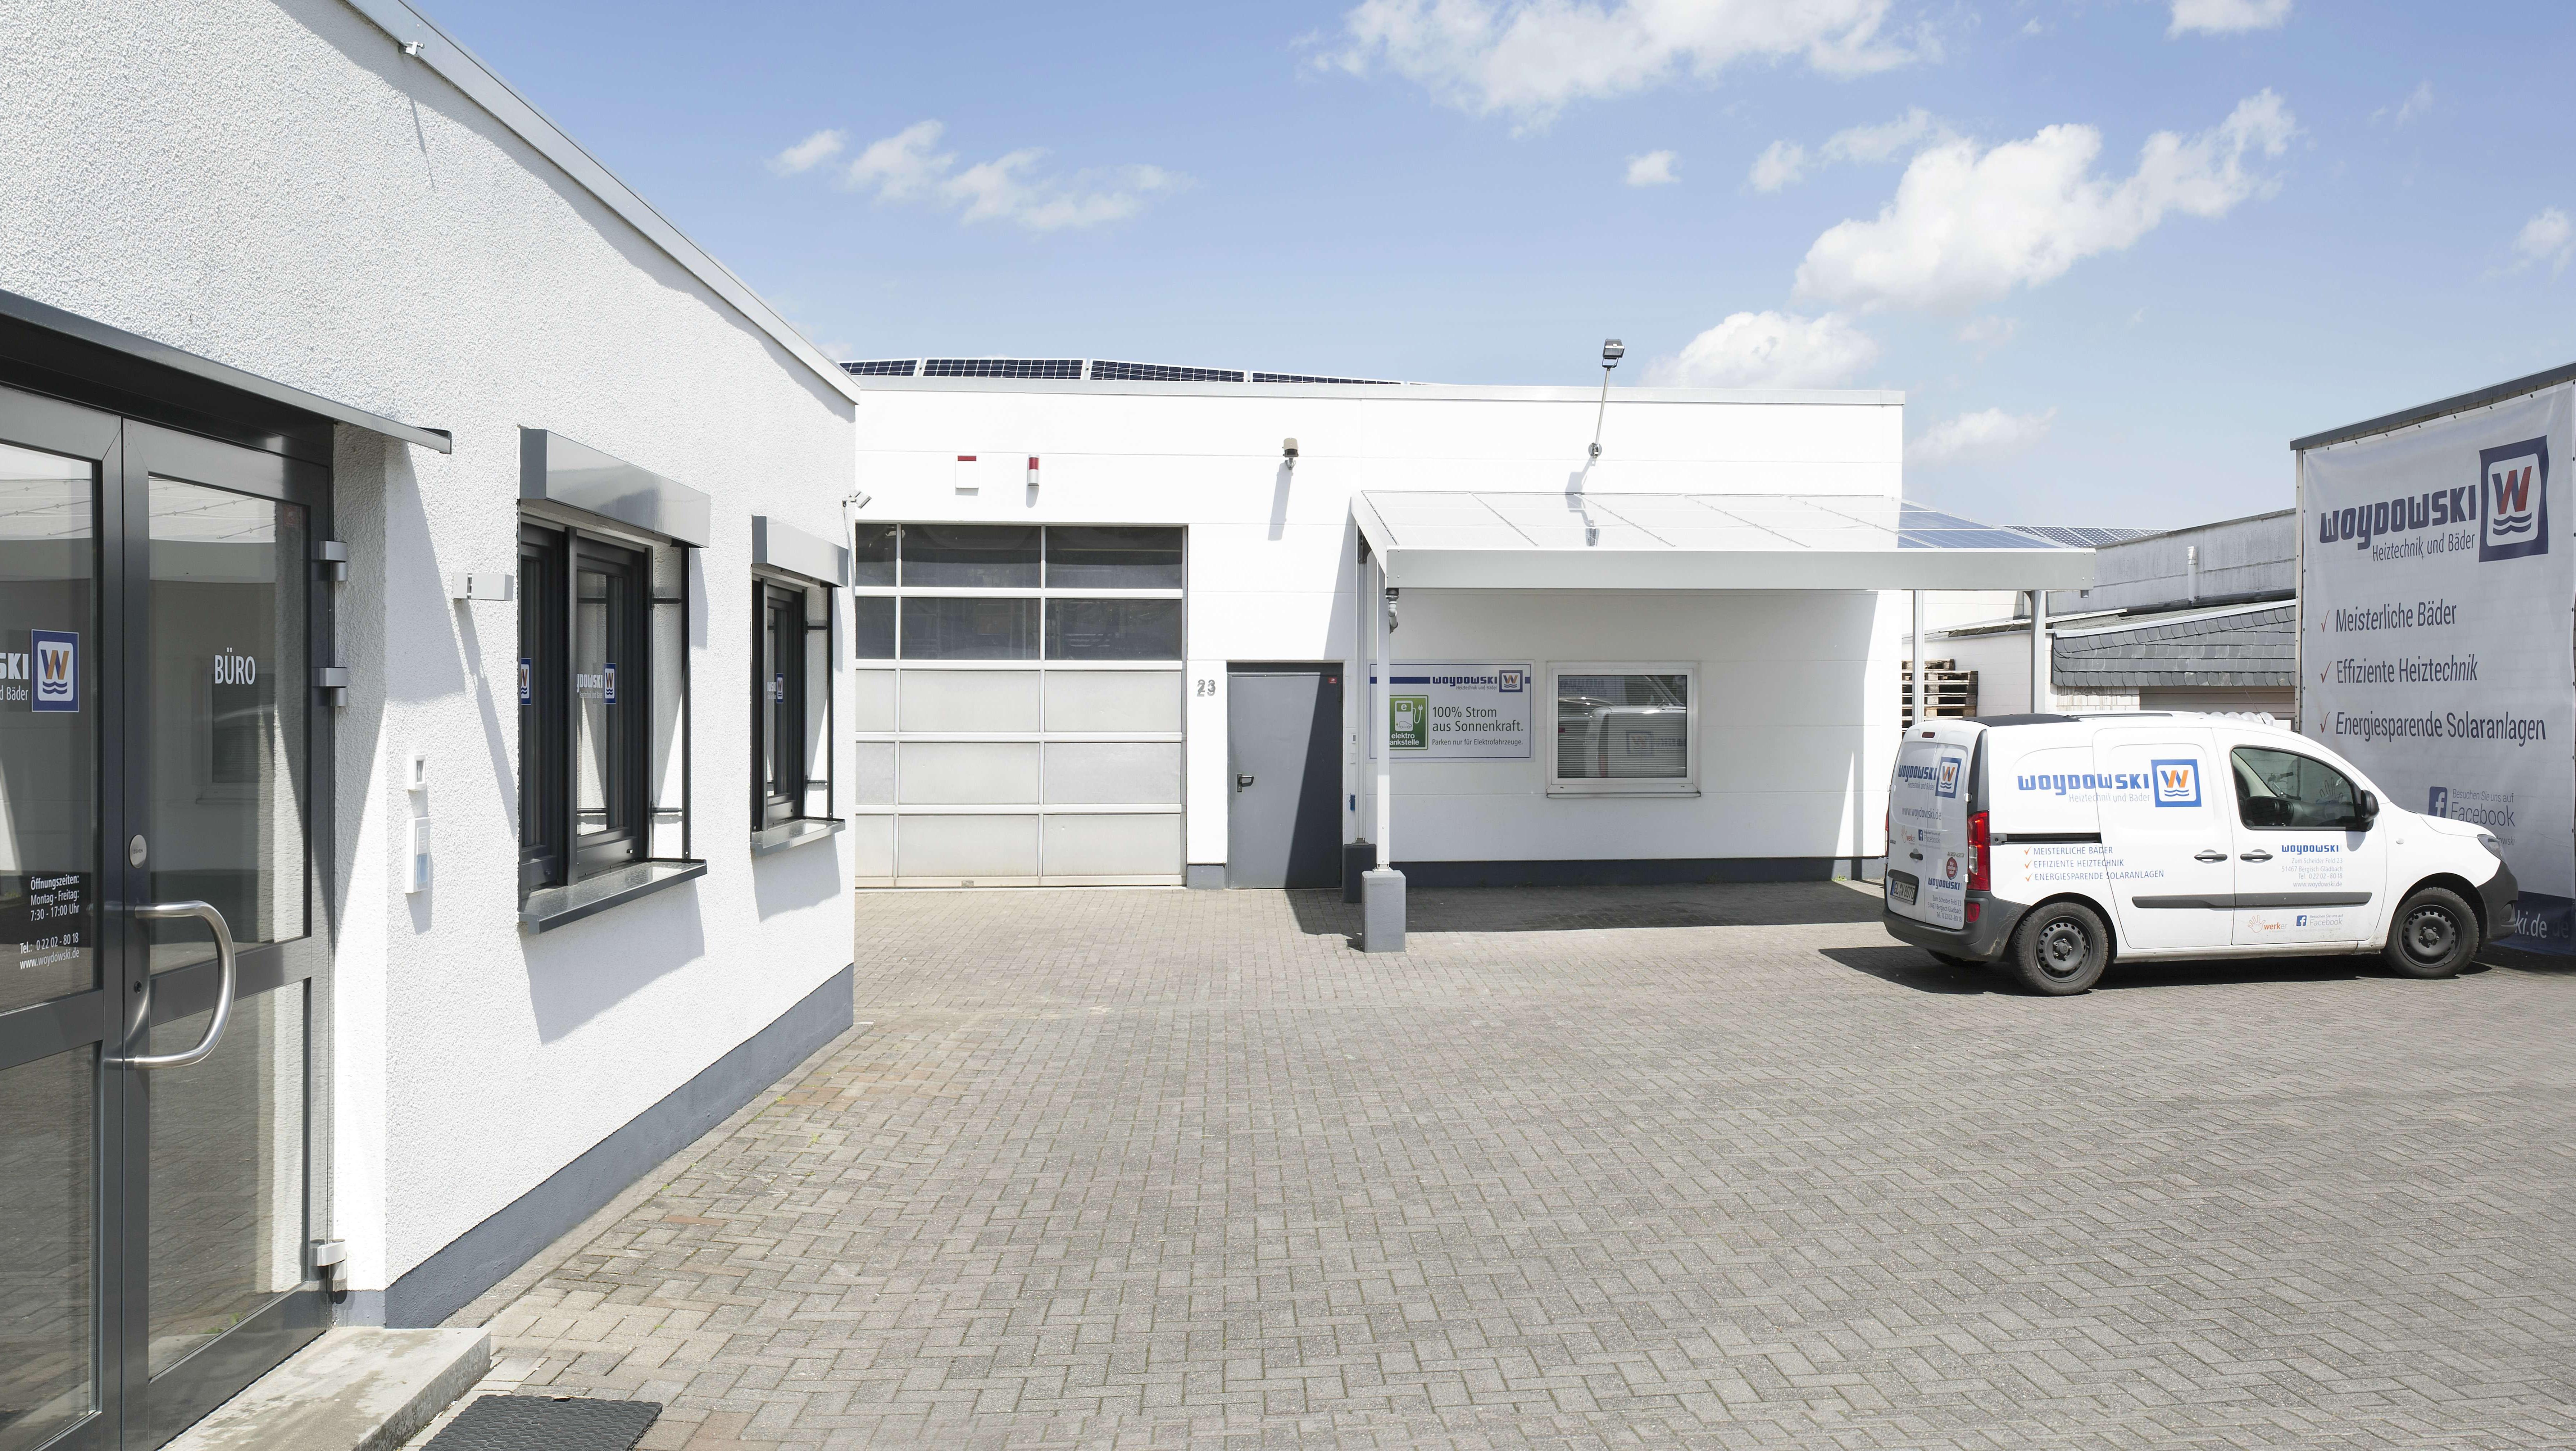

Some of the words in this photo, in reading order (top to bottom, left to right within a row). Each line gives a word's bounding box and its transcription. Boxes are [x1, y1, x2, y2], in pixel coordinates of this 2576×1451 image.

[2320, 485, 2476, 550] WOYDOWSKI
[2373, 536, 2423, 562] Heiztechnik
[2427, 532, 2444, 554] und
[2448, 530, 2475, 552] Bäder
[2336, 602, 2413, 632] Meisterliche
[2418, 598, 2457, 626] Bäder
[215, 647, 255, 685] BÜRO
[2337, 658, 2395, 683] Effiziente
[2399, 654, 2478, 682] Heiztechnik
[1198, 679, 1216, 693] 23
[1432, 676, 1497, 686] WOYDOWSKI
[6, 685, 28, 700] Bäder
[1432, 707, 1462, 718] 100%
[1466, 707, 1496, 717] Strom
[1432, 722, 1451, 731] aus
[1455, 720, 1523, 731] Sonnenkraft.
[2336, 711, 2443, 742] Energiesparende
[2446, 711, 2546, 747] Solaranlagen
[1898, 765, 1937, 782] WOYDOWSKI
[2017, 774, 2149, 795] WOYDOWSKI
[2069, 793, 2111, 802] Heiztechnik
[2113, 793, 2126, 802] und
[2129, 793, 2150, 802] Bäder
[2453, 789, 2480, 800] Besuchen
[2481, 791, 2489, 801] Sie
[2503, 793, 2514, 803] auf
[1902, 807, 1941, 820] www.woydowski.de
[2451, 802, 2515, 827] Facebook
[2497, 835, 2515, 845] owski
[2089, 845, 2113, 854] BÄDER
[2282, 845, 2339, 855] WOYDOWSKI
[31, 874, 79, 890] Öffnungszeiten:
[2106, 870, 2164, 879] SOLARANLAGEN
[1928, 878, 1961, 890] WOYDOWSKI
[31, 894, 53, 906] Montag
[58, 889, 79, 901] Freitag:
[31, 909, 44, 921] 7:30
[51, 904, 67, 917] 17:00
[69, 902, 79, 914] Uhr
[20, 942, 32, 954] Tel.:
[36, 940, 40, 951] 0
[42, 938, 49, 949] 22
[51, 936, 58, 948] 02
[63, 934, 71, 945] 80
[72, 932, 78, 943] 18
[20, 947, 79, 969] www.woydowski.de
